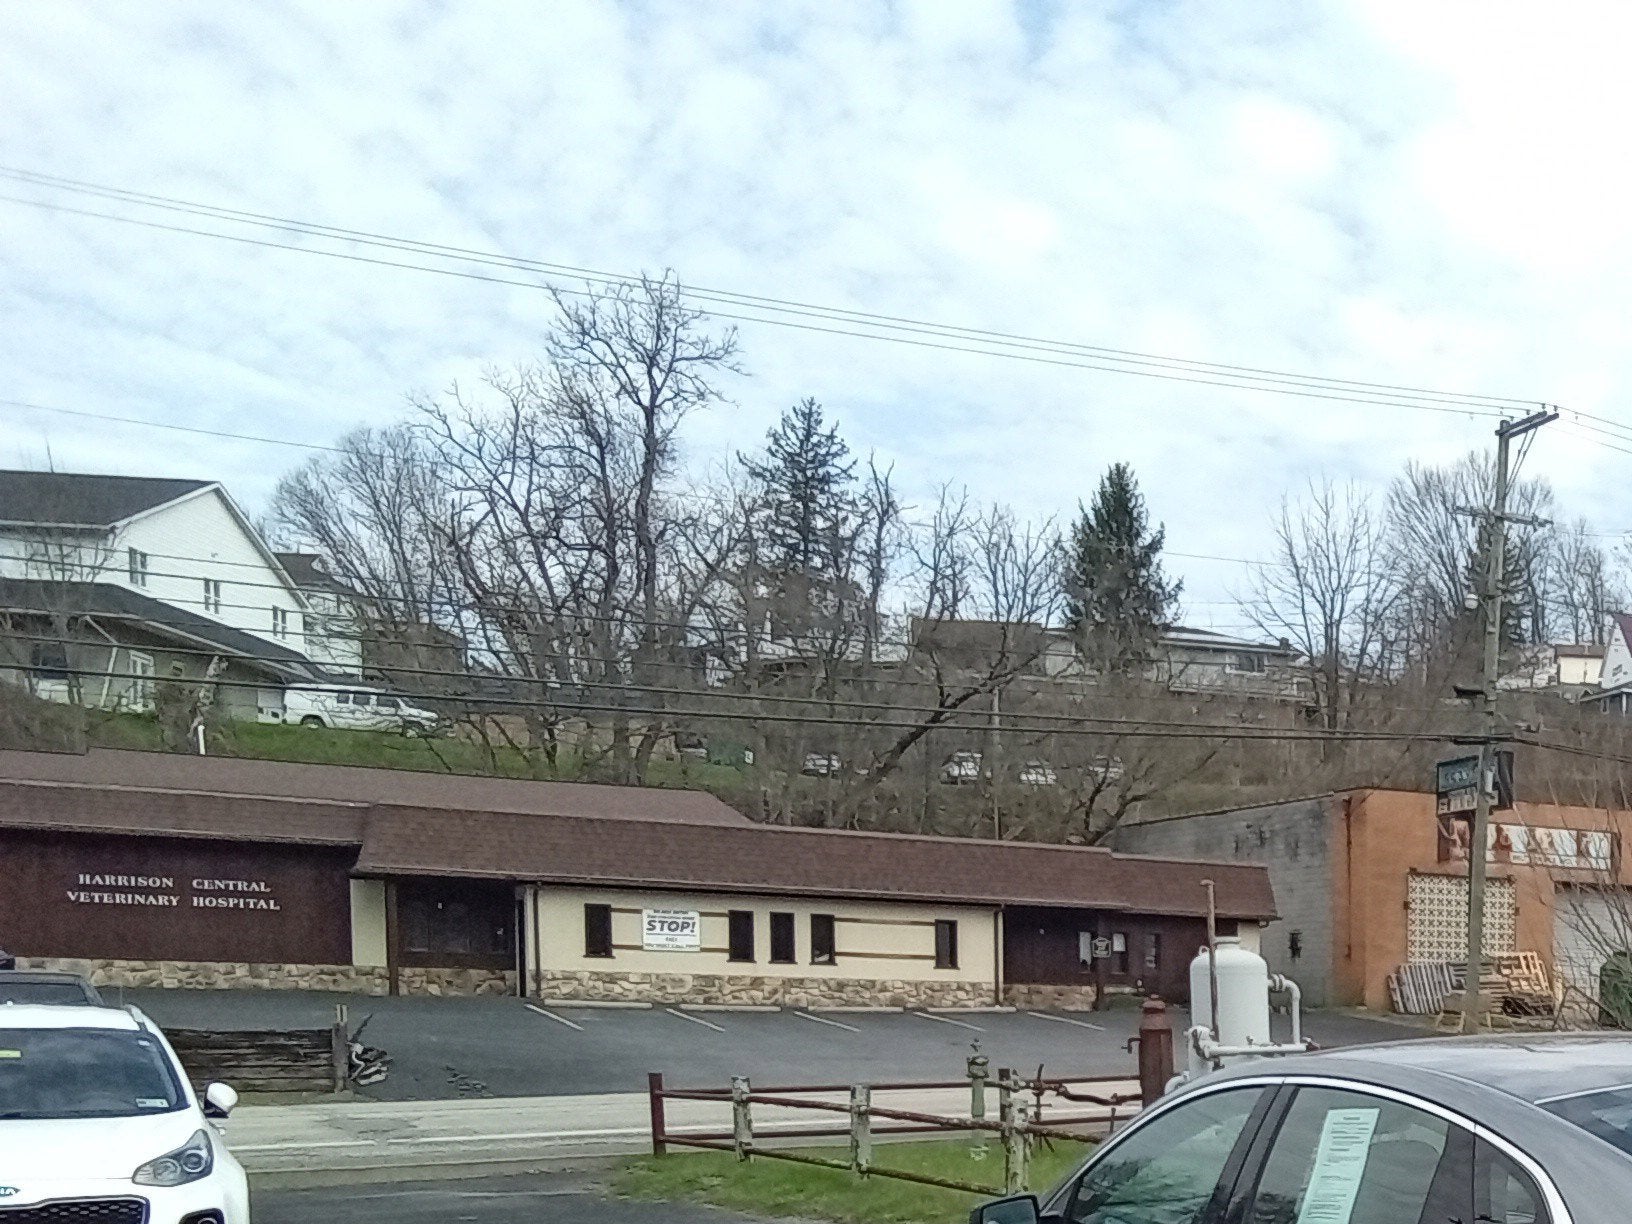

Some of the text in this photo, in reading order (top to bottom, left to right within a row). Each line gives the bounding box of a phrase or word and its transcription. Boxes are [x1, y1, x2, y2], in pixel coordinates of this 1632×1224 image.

[78, 873, 271, 893] HARRISON CENTRAL
[67, 890, 280, 911] VETERINARY HOSPITAL
[646, 919, 696, 933] STOP!
